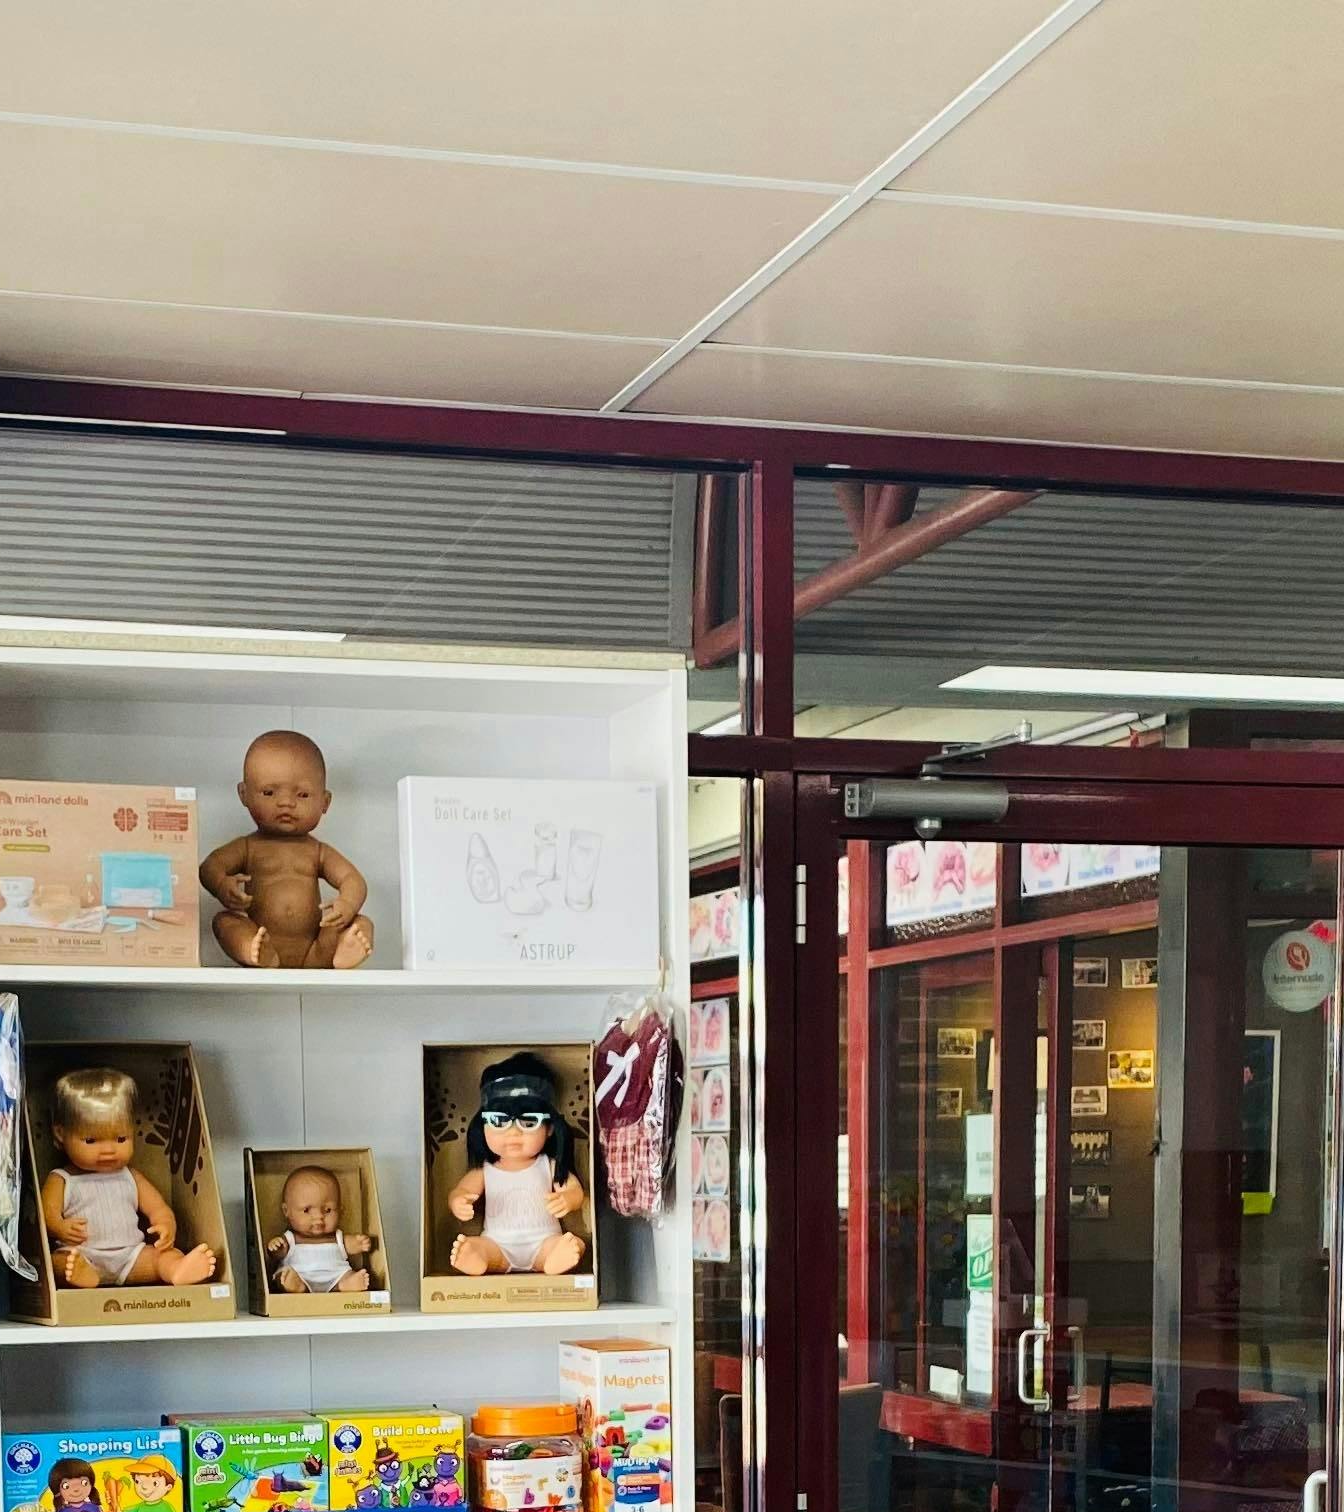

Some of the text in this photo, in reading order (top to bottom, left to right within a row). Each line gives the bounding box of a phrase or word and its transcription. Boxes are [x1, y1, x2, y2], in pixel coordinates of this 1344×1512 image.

[63, 794, 89, 807] dolls
[434, 806, 458, 822] Doll
[462, 807, 489, 822] Care
[25, 826, 48, 838] Set
[520, 943, 576, 961] ASTRUP
[122, 1298, 191, 1311] miniland dolls
[603, 1374, 665, 1389] Magnets
[371, 1425, 414, 1438] Build a
[58, 1436, 166, 1455] Shopping List
[229, 1433, 262, 1446] Little
[263, 1432, 288, 1446] Bug
